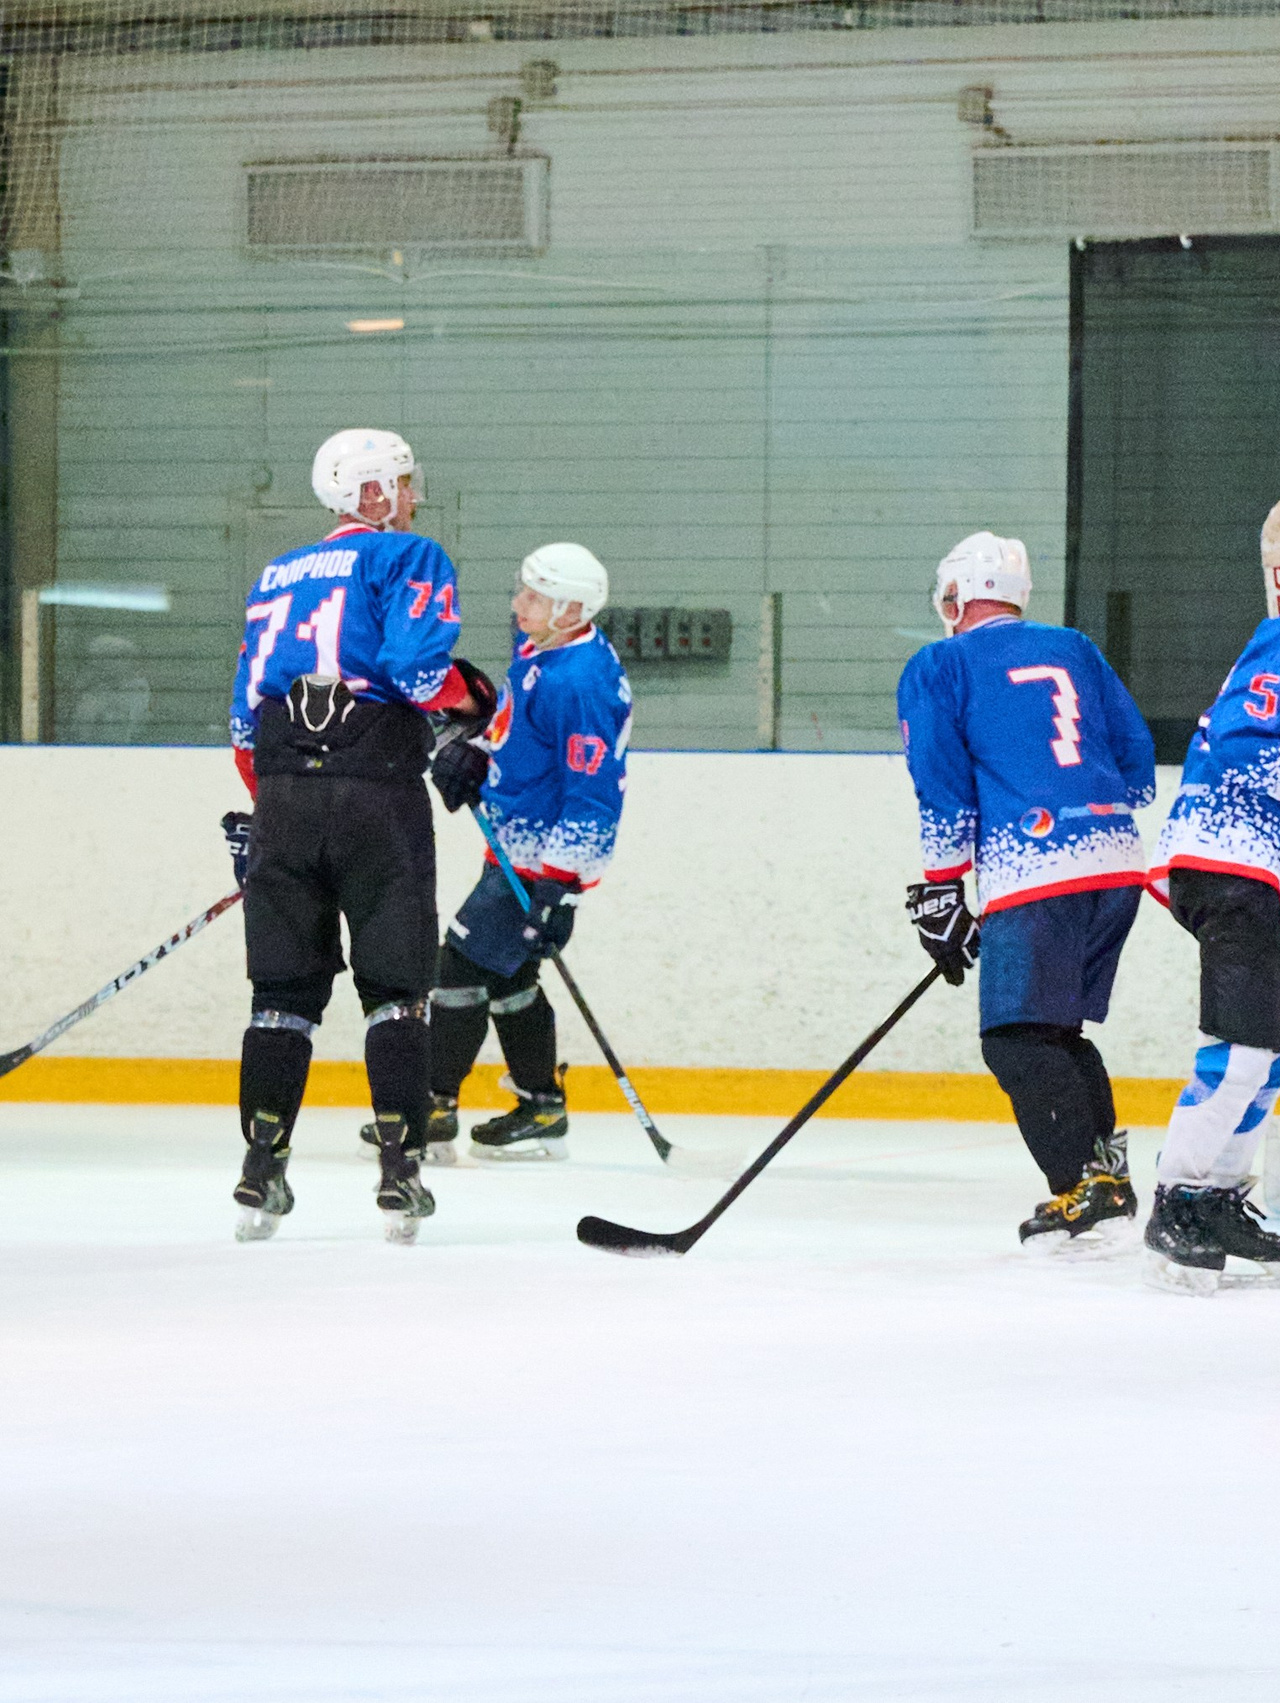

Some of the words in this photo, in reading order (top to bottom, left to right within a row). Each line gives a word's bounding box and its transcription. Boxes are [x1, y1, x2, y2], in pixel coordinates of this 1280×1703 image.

[259, 549, 359, 593] СМИРНОВ
[407, 578, 461, 623] 71
[246, 587, 370, 711] 71
[1007, 664, 1082, 768] 7
[909, 891, 958, 921] UER
